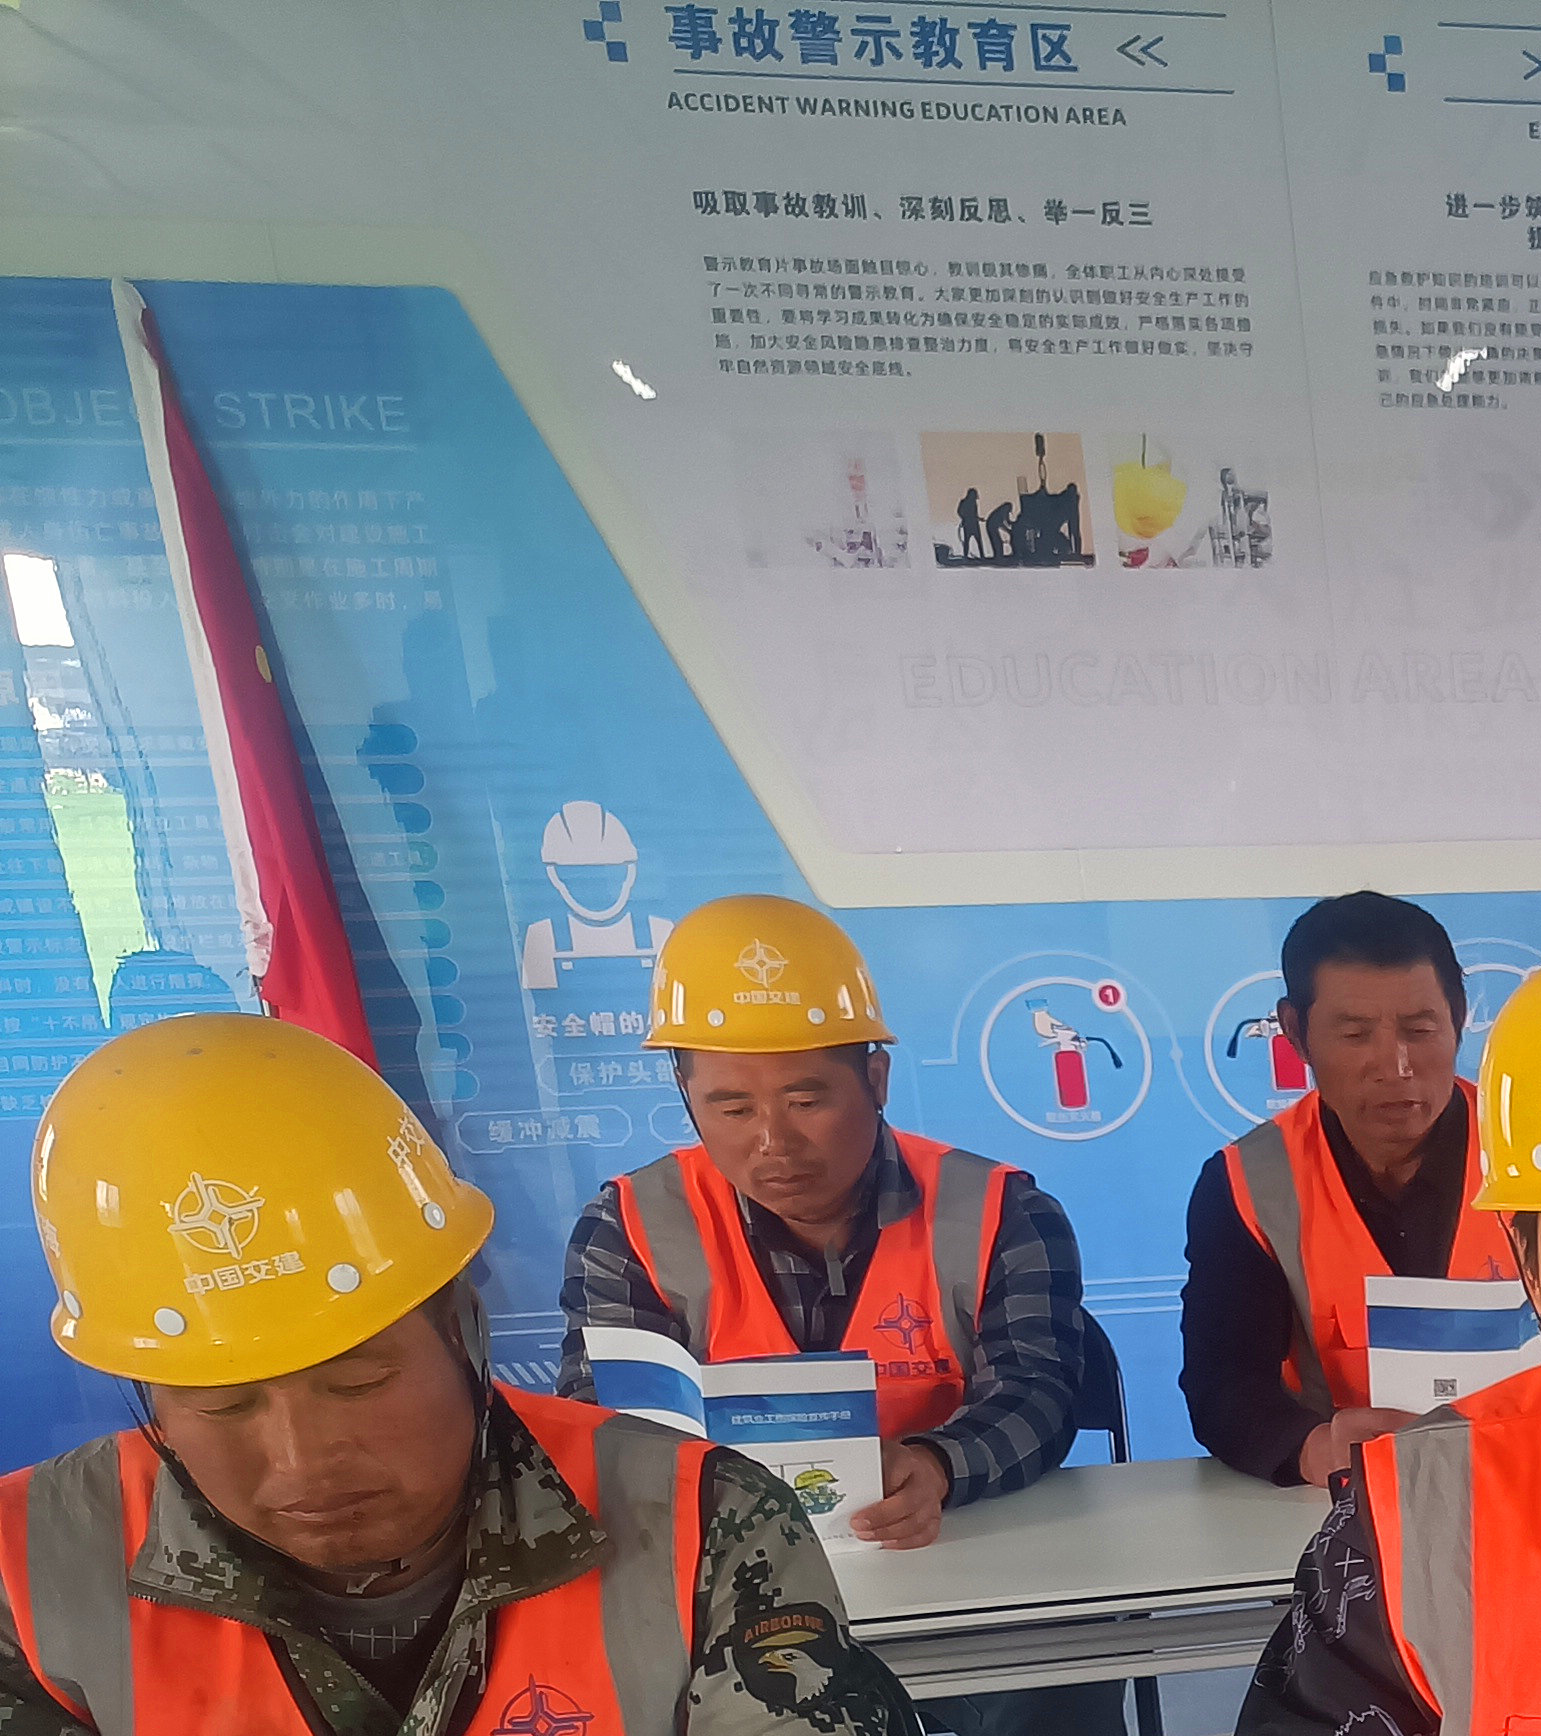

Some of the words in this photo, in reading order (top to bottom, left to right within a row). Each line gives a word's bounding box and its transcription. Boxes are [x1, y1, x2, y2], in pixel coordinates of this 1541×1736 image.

[667, 4, 1079, 73] 事故警示教育区
[667, 91, 790, 115] ACCIDENT
[798, 96, 914, 120] WARNING
[921, 99, 1058, 124] EDUCATION
[1066, 106, 1127, 126] AREA
[693, 190, 1154, 227] 吸取事故教训、深刻反思、举一反三
[214, 391, 410, 434] STRIKE
[900, 652, 1335, 711] EDUCATION
[1350, 652, 1537, 705] AREA
[532, 1011, 653, 1038] 安全帽的
[183, 1250, 306, 1296] 中国交建
